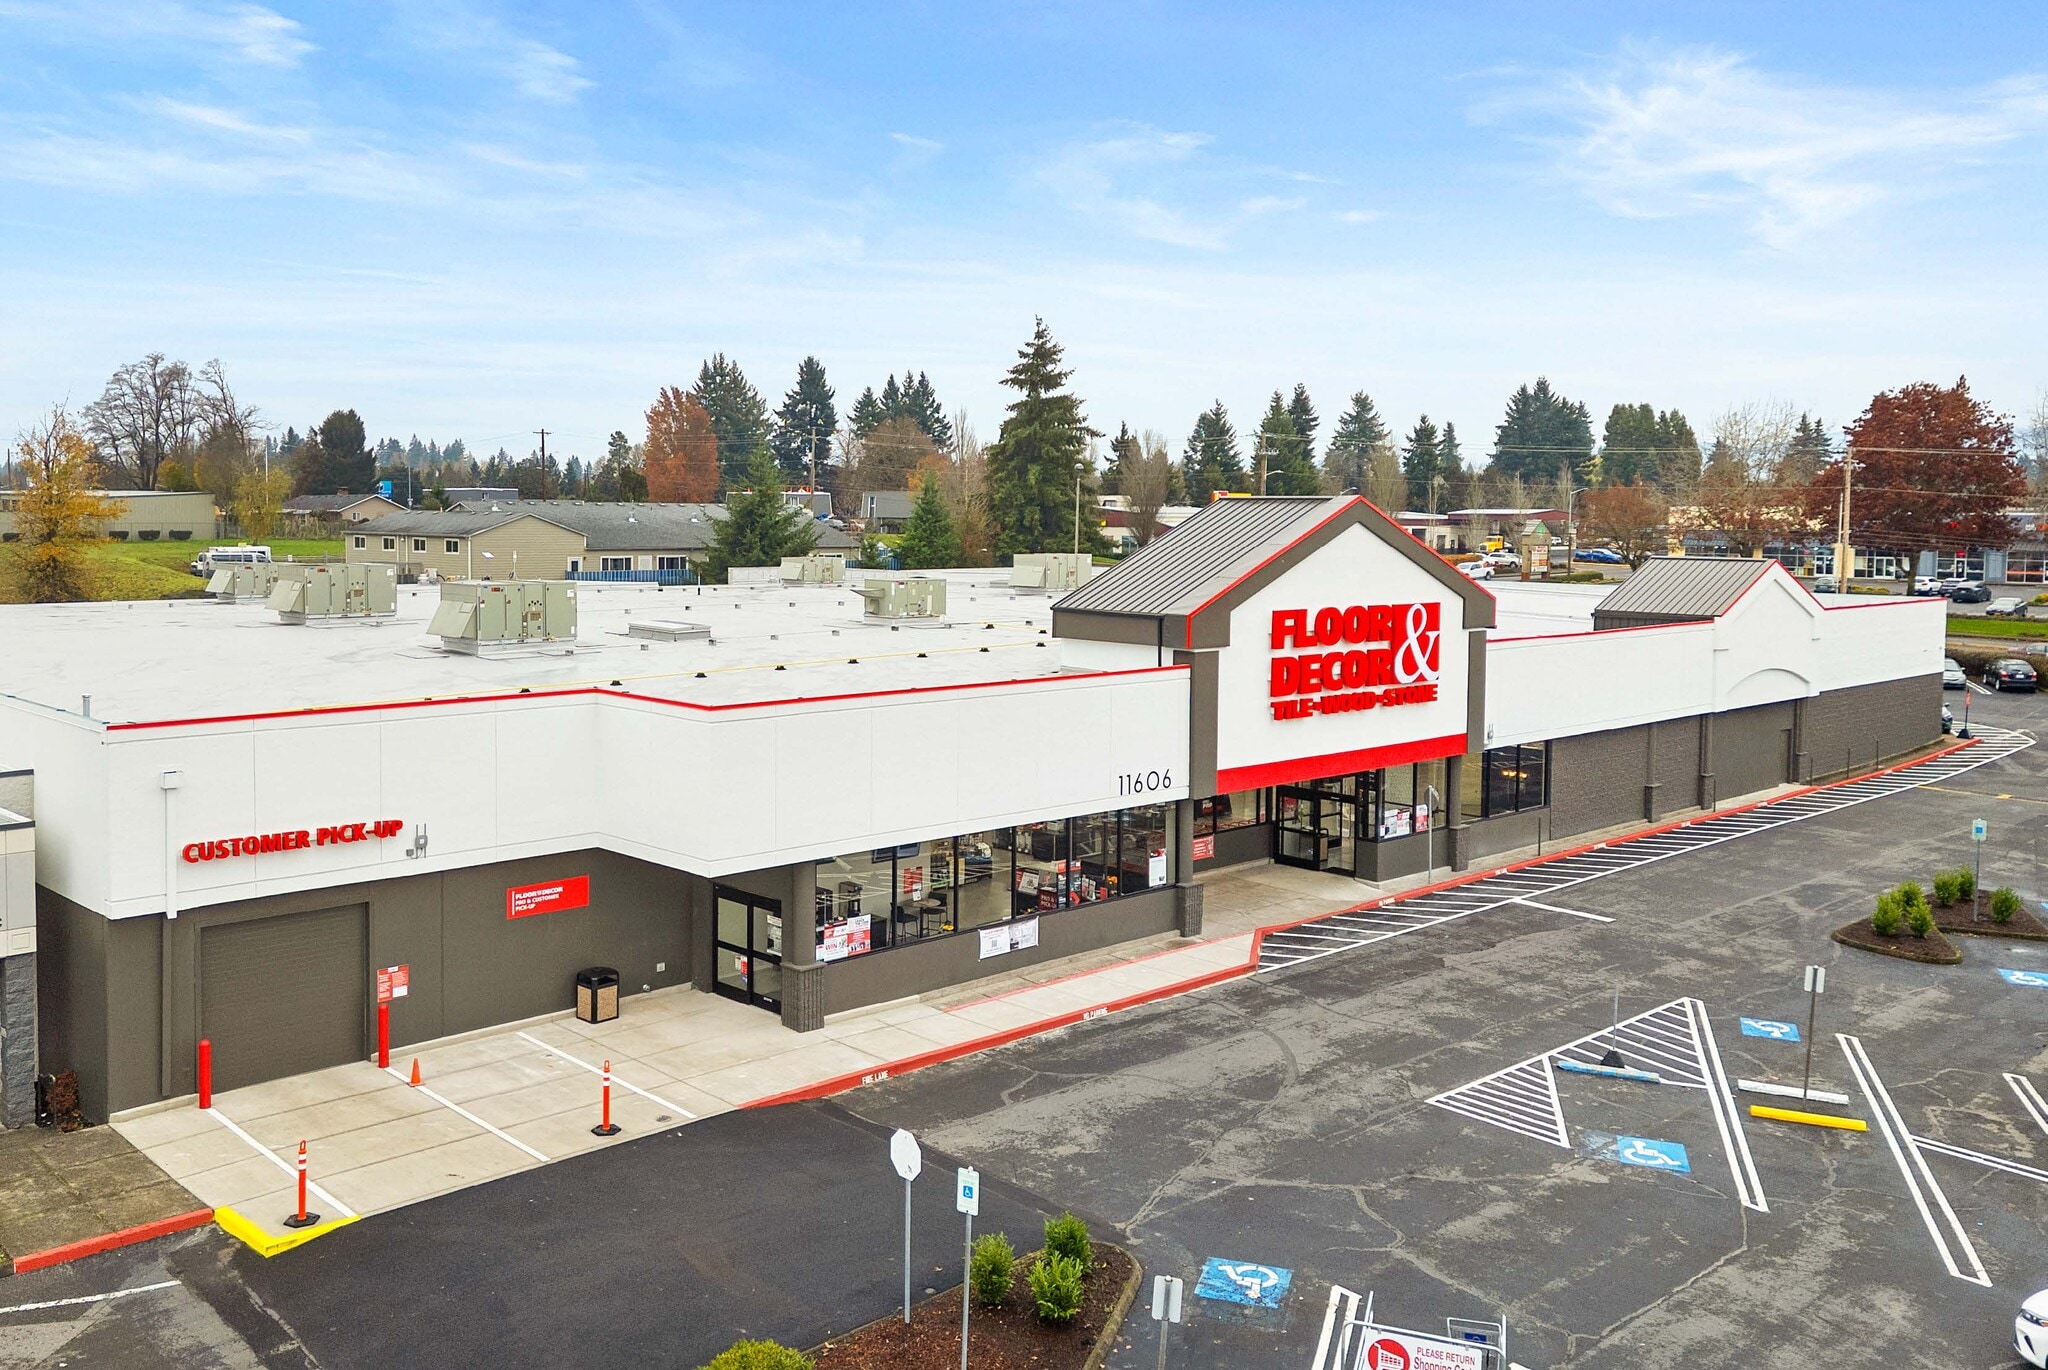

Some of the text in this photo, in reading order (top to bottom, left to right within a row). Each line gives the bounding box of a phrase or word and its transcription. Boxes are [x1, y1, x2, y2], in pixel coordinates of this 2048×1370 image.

[1271, 605, 1393, 649] FLOOR
[1394, 603, 1441, 684] &
[1270, 648, 1393, 697] DECOR
[1118, 768, 1172, 796] 11606
[182, 820, 403, 863] CUSTOMER PICK-UP
[1413, 1356, 1452, 1370] Shoppi
[1416, 1346, 1476, 1366] PLEASE RETURN
